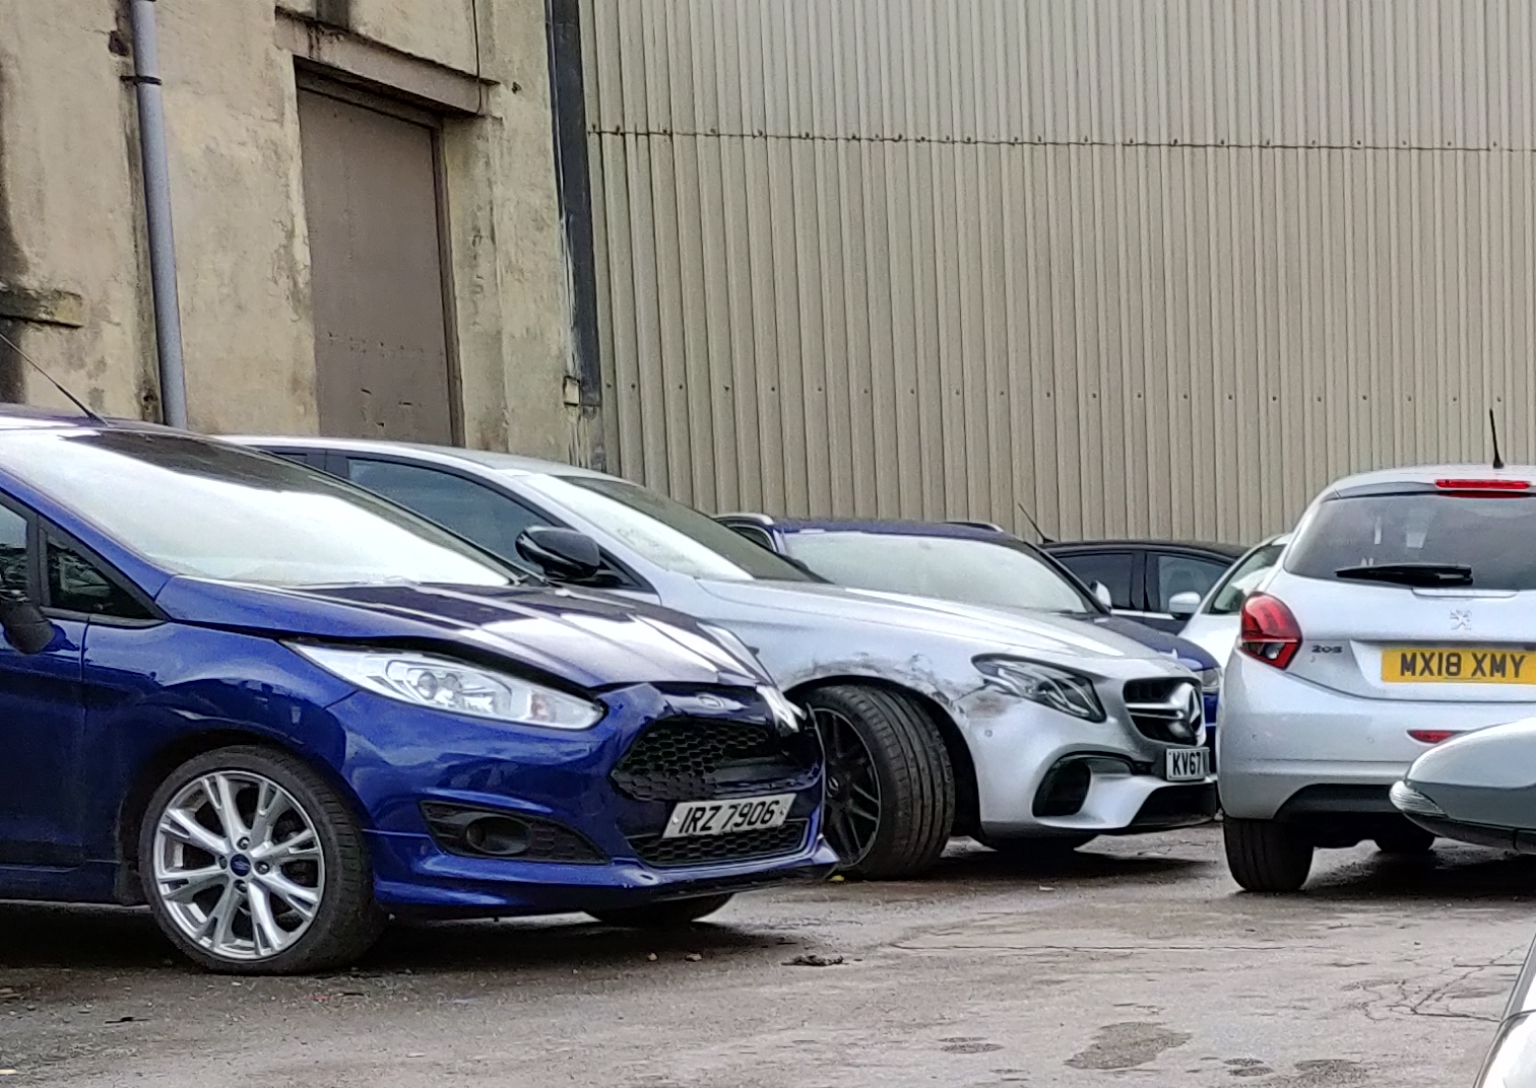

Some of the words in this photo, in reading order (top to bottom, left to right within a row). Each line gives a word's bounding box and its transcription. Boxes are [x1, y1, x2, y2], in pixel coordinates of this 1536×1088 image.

[1400, 652, 1461, 677] MX18
[1471, 654, 1526, 678] XMY
[1172, 751, 1201, 776] KV67
[679, 806, 721, 834] IRZ
[722, 800, 780, 831] 7906
